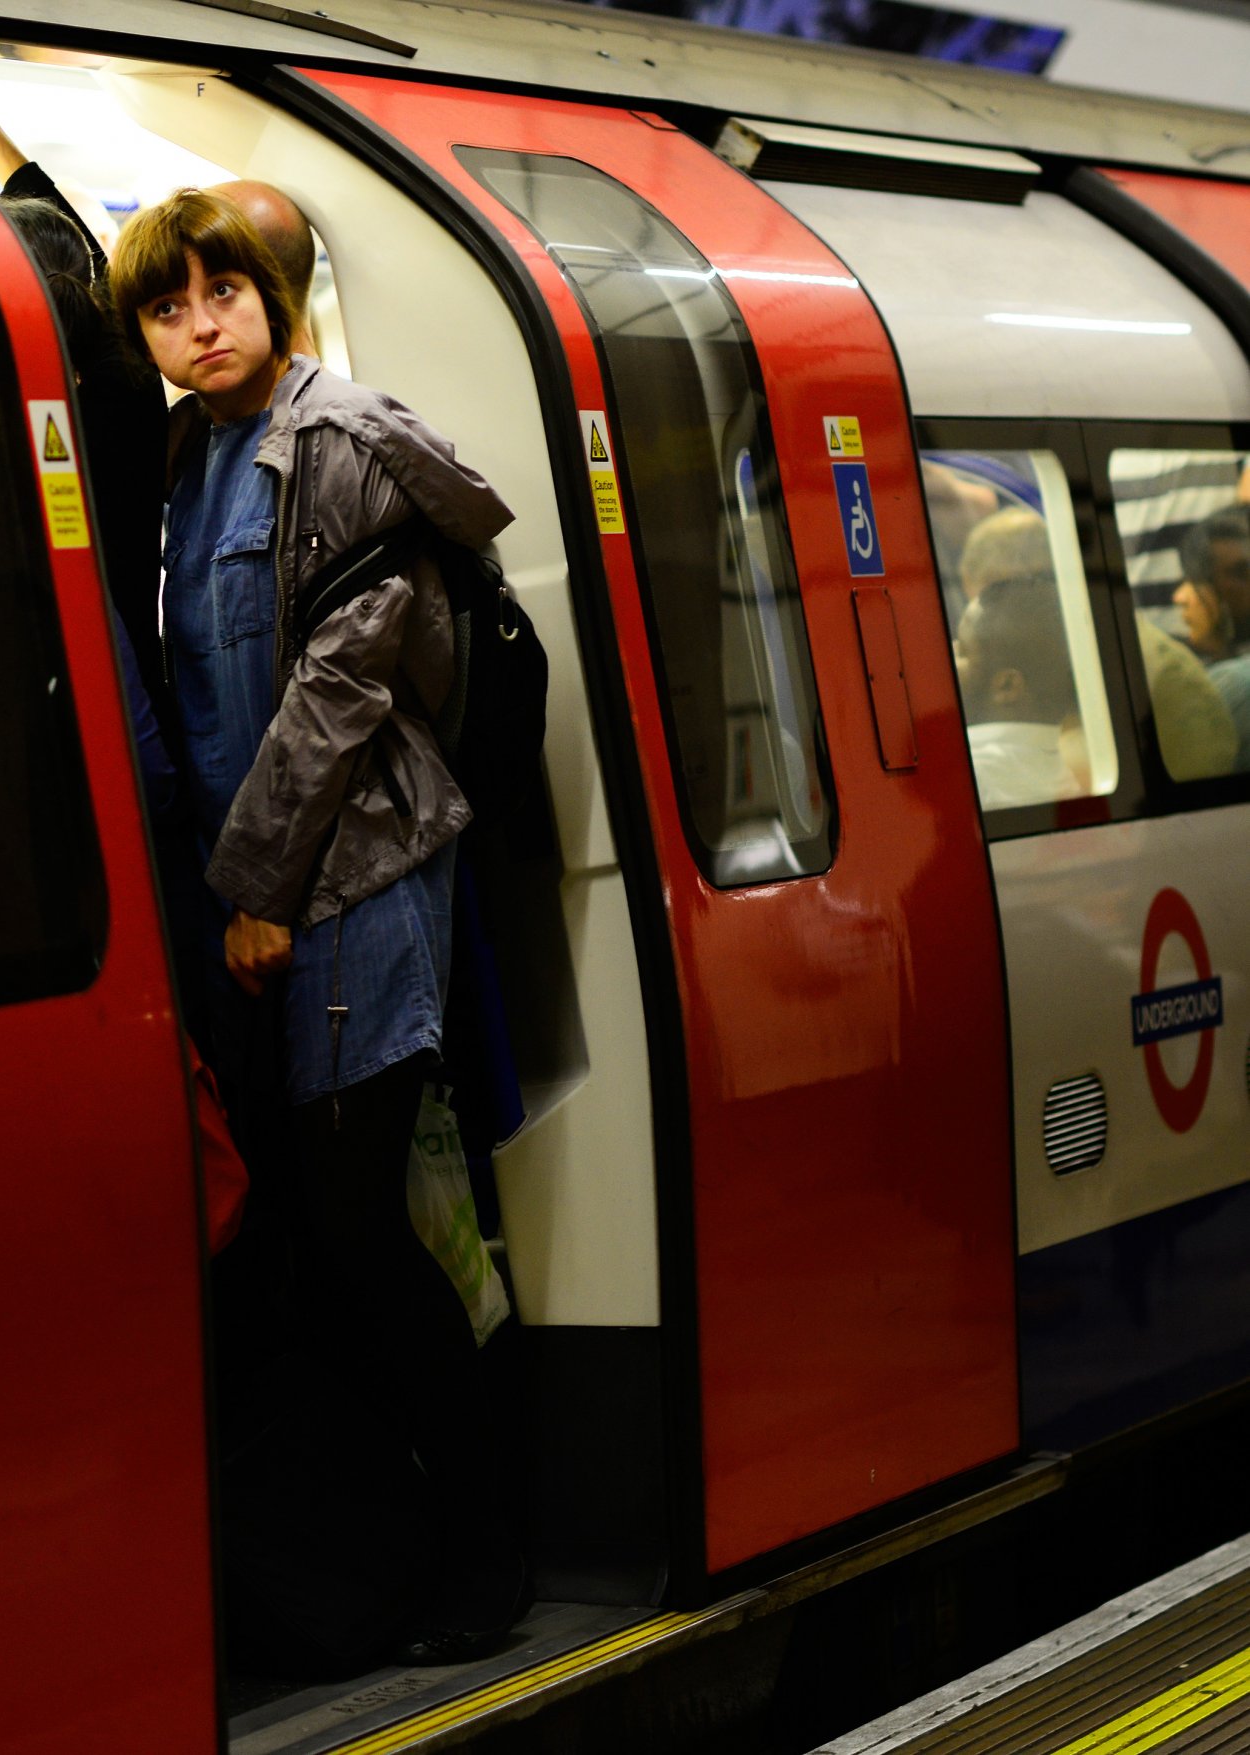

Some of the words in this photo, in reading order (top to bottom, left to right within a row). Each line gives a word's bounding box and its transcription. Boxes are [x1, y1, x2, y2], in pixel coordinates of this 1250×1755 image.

[197, 82, 206, 97] F
[594, 480, 614, 491] Caution
[1136, 988, 1219, 1034] UNDERGROUND
